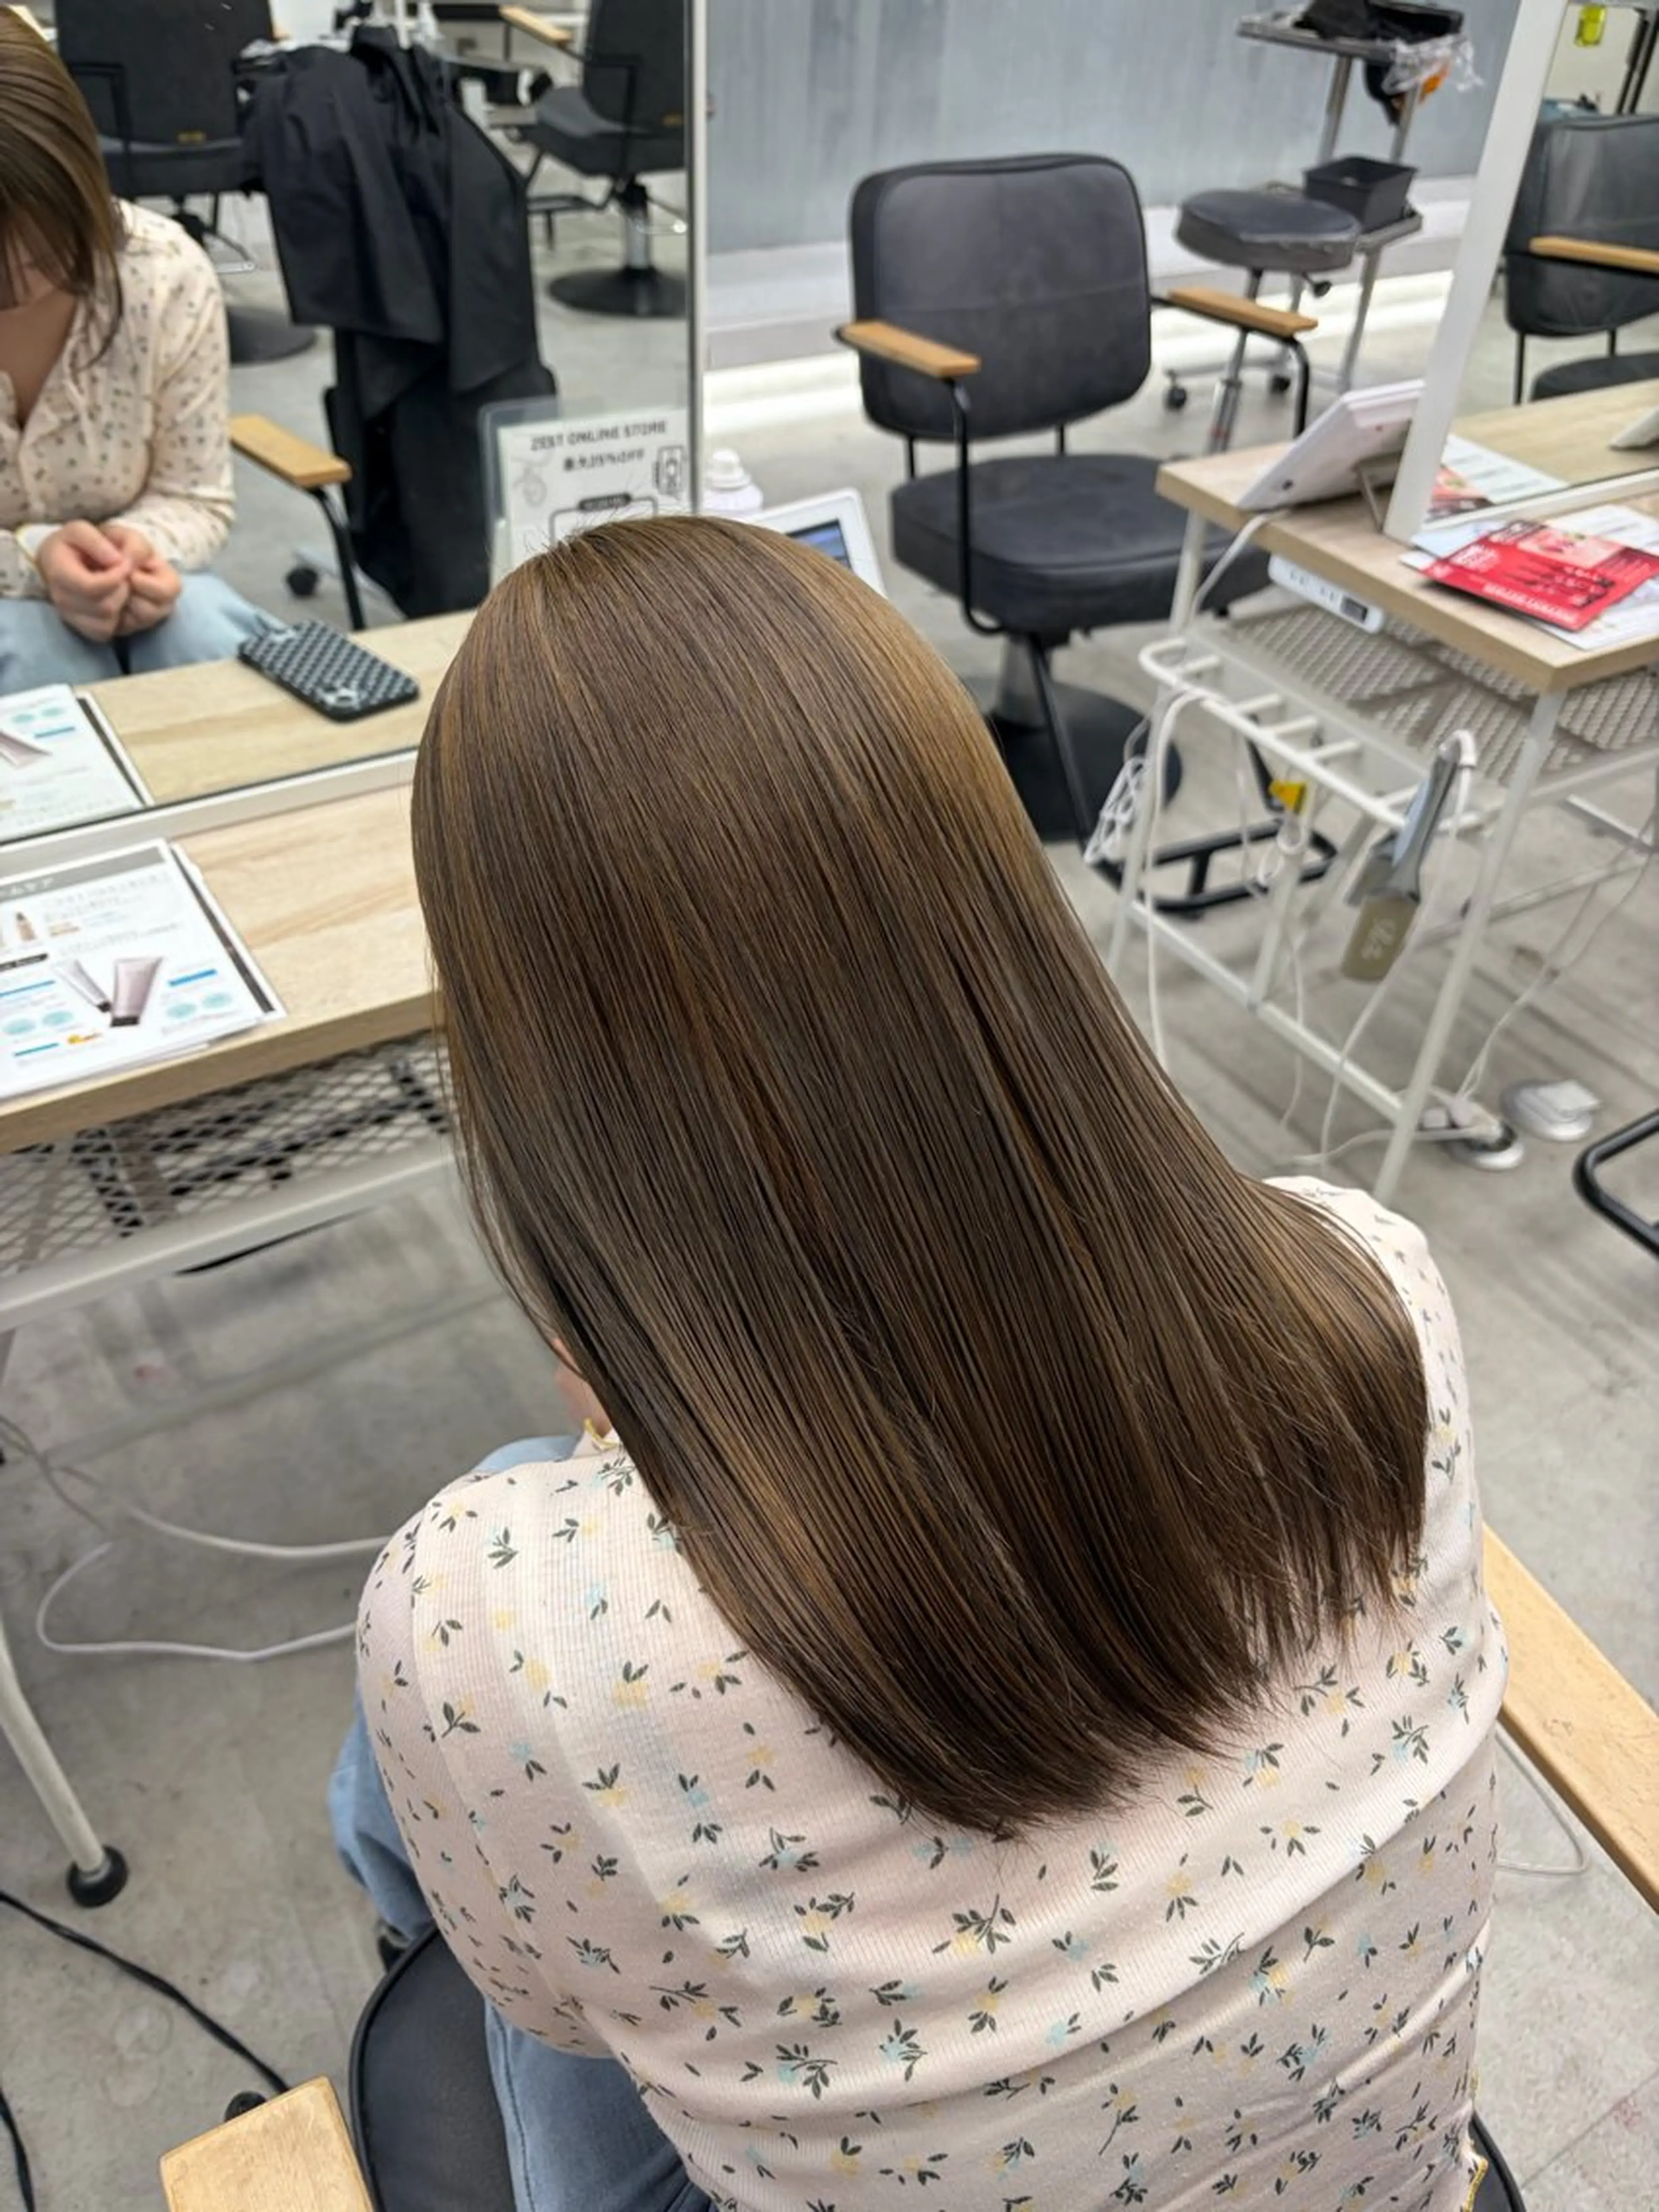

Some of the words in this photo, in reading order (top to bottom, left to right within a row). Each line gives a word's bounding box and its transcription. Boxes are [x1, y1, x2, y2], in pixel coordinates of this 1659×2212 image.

[531, 435, 563, 451] ZEST
[567, 427, 619, 445] ONLINE
[625, 421, 666, 436] STORE
